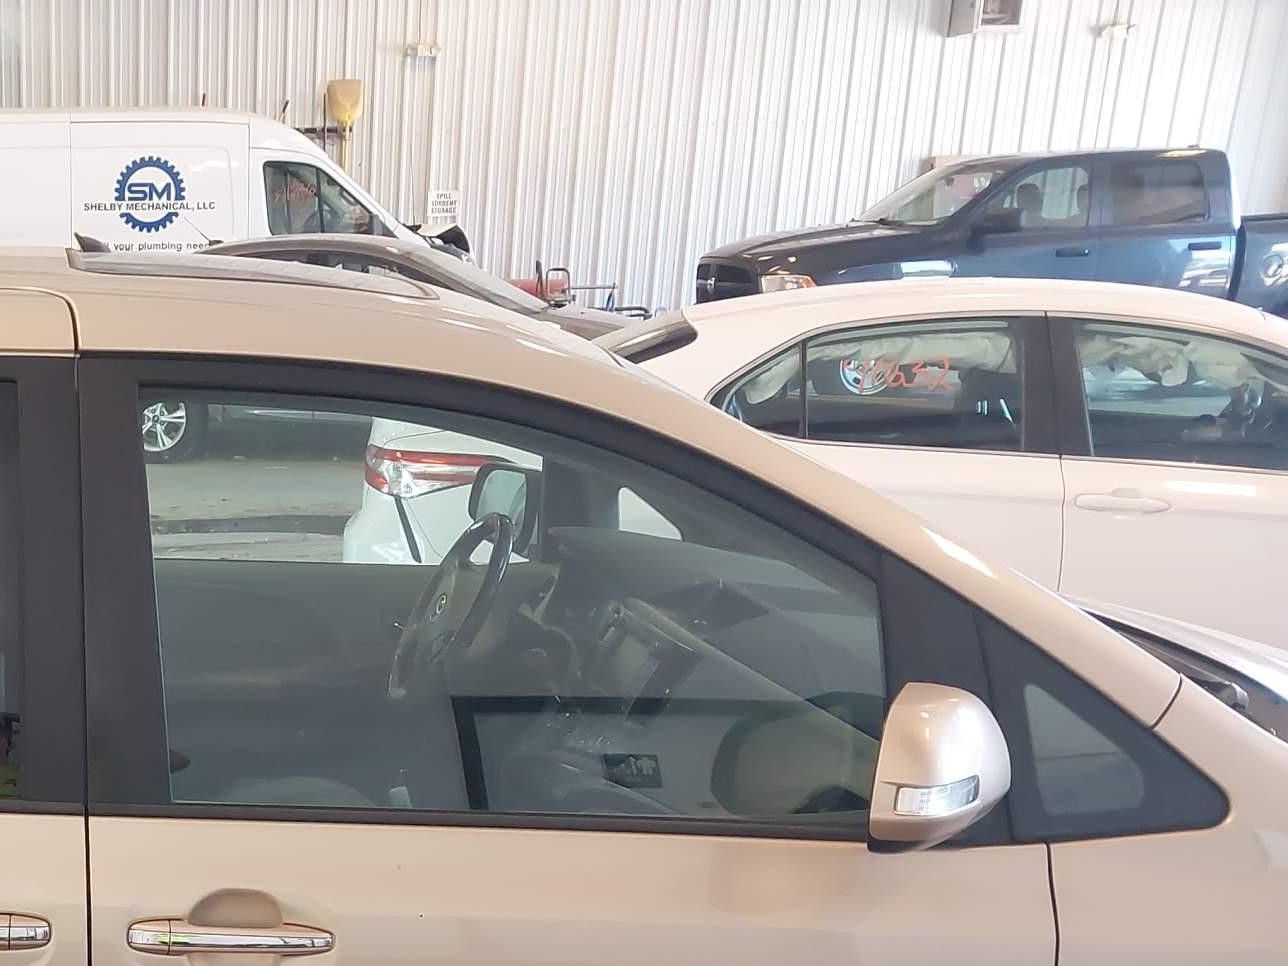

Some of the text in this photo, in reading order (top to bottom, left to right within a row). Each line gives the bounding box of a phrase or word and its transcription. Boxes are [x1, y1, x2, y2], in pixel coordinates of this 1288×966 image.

[127, 182, 172, 201] SM
[83, 201, 216, 212] SHELBY MECHANICAL, LLC
[114, 242, 135, 251] your
[138, 241, 182, 252] plumbing
